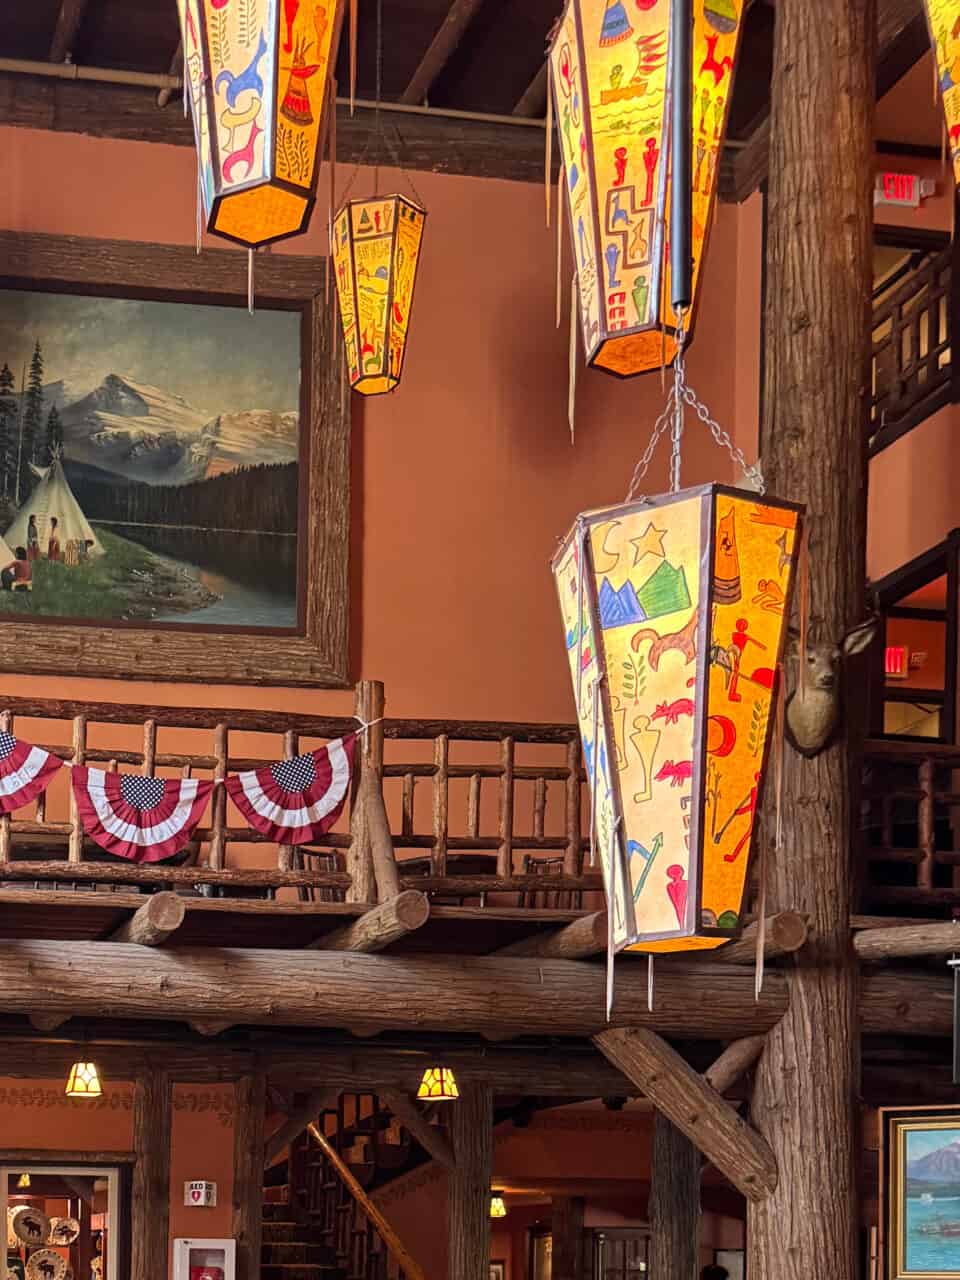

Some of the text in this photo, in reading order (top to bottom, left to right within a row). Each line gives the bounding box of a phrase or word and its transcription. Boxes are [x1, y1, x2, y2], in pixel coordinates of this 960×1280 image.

[883, 172, 915, 201] EXIT
[885, 647, 905, 673] IT
[189, 1182, 204, 1190] AED
